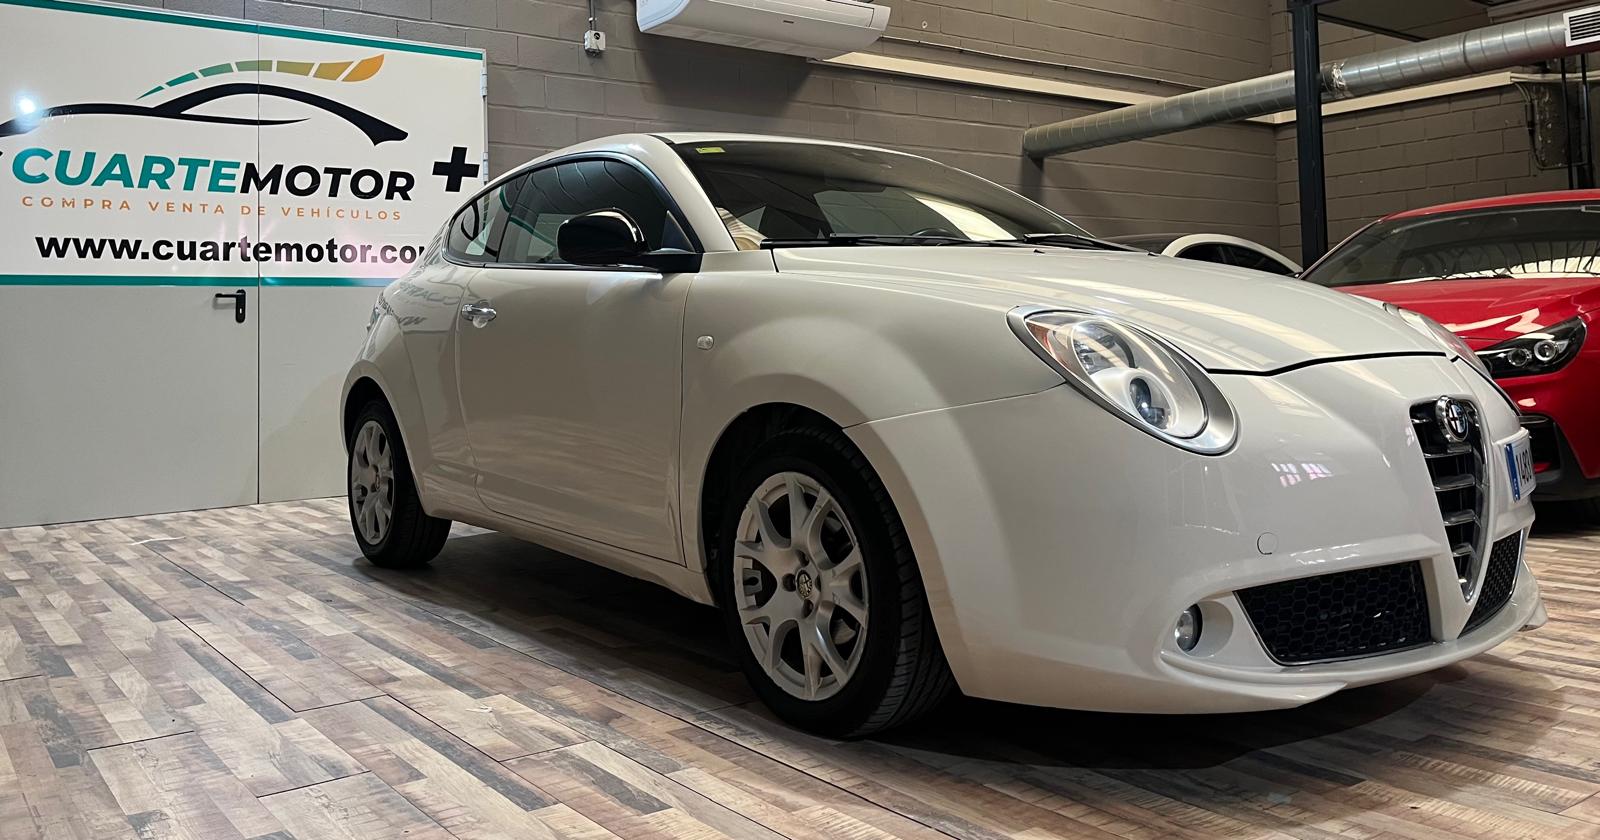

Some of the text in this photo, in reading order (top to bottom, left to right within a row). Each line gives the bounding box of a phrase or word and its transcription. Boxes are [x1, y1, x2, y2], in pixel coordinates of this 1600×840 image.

[12, 147, 415, 201] CUARTEMOTOR
[22, 196, 401, 221] COMPRA VENTA DE VEHÍCULOS
[35, 236, 425, 265] www.cuartemotor.co
